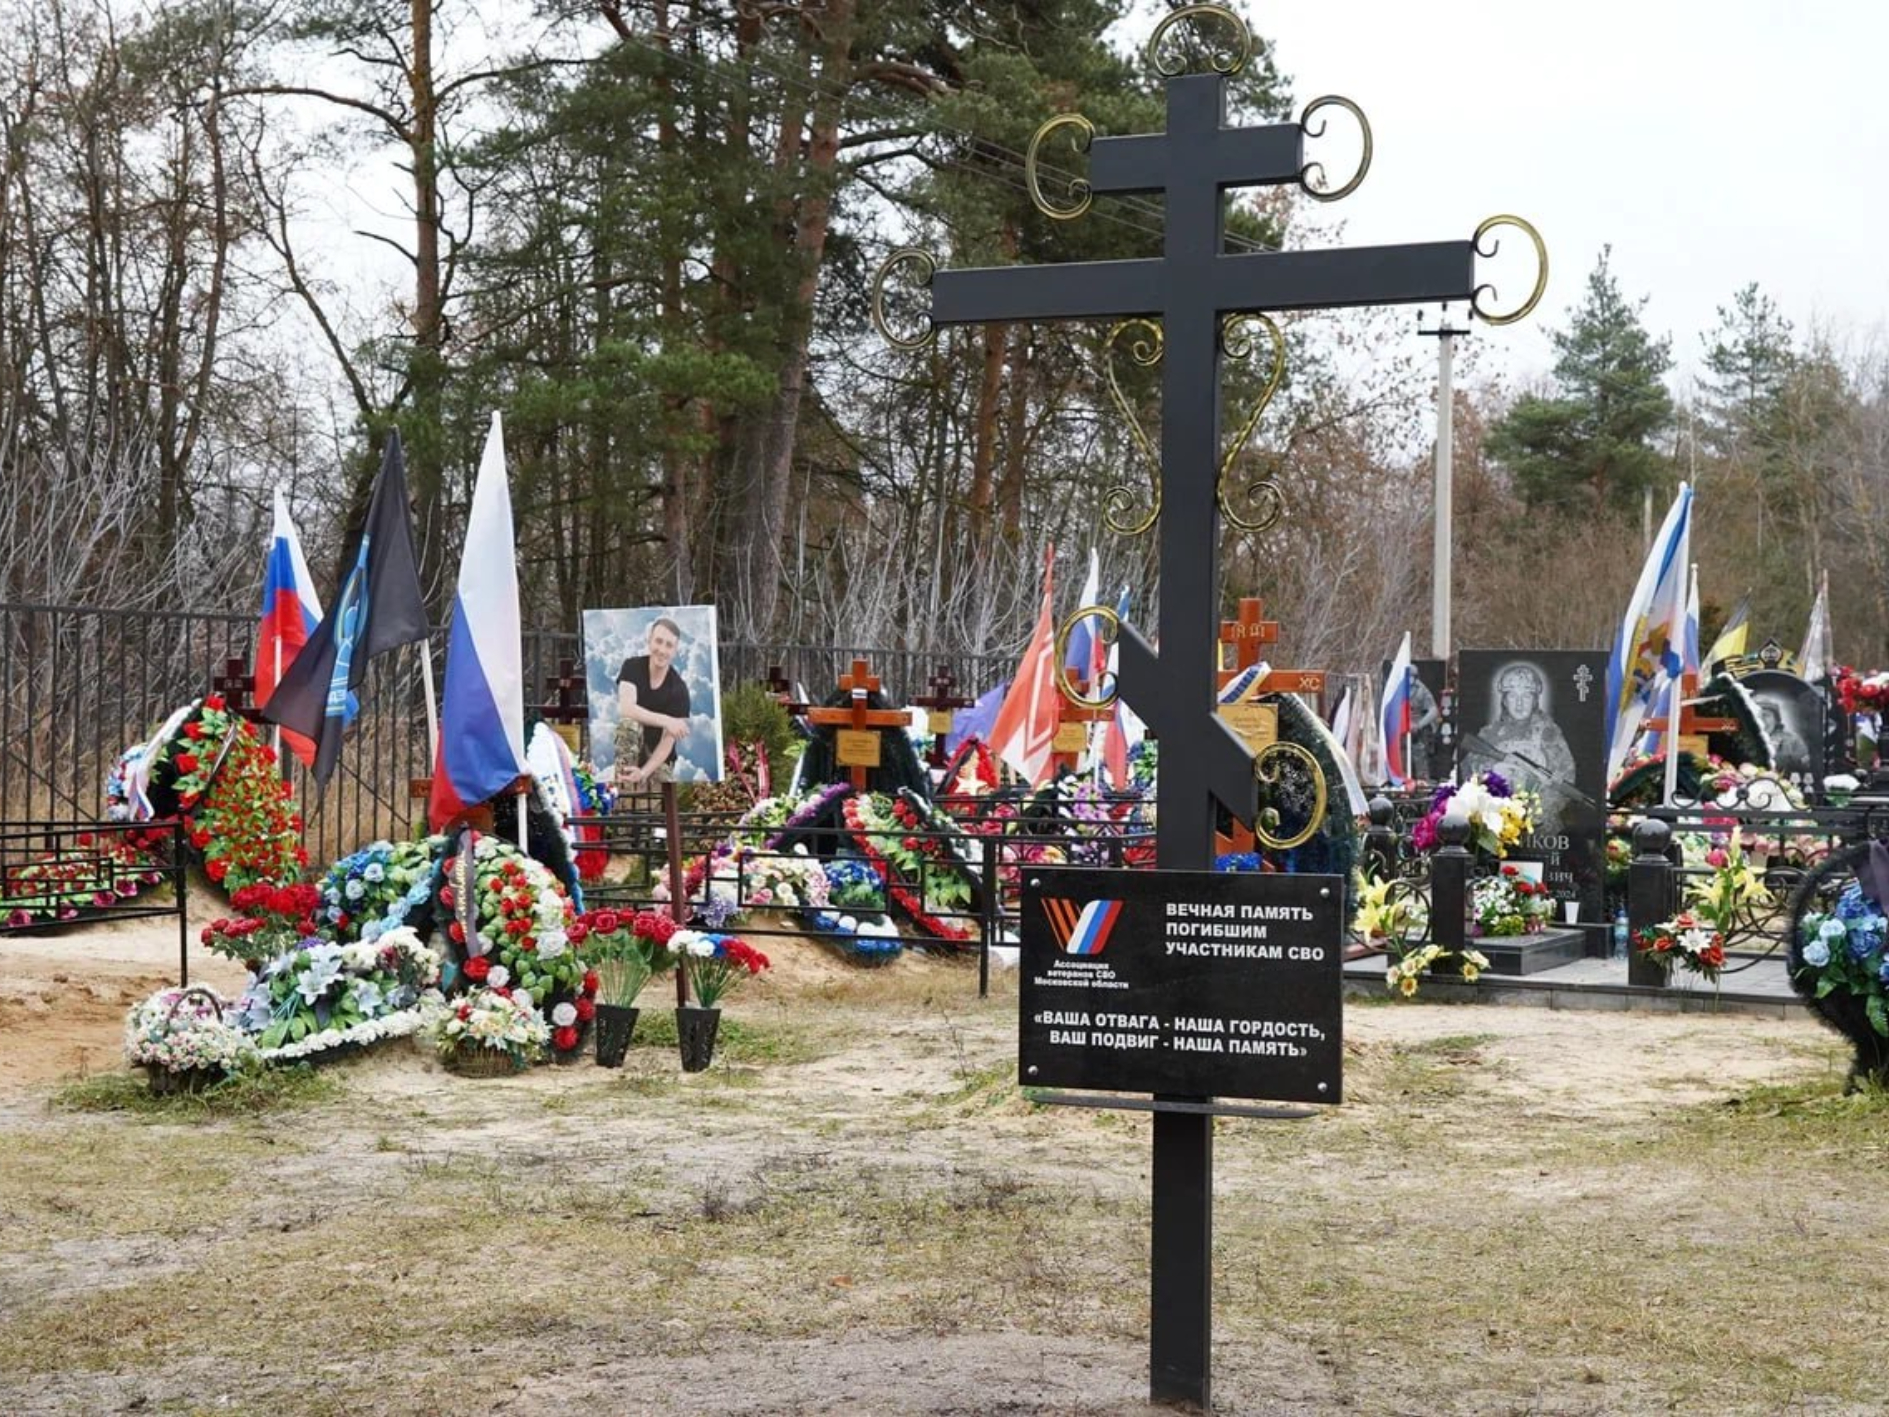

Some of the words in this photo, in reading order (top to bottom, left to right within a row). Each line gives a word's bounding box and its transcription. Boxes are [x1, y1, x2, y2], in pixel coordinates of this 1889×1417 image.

[1165, 903, 1236, 918] ВЕЧНАЯ
[1240, 905, 1314, 921] ПАМЯТЬ
[1165, 922, 1268, 939] ПОГИБШИМ
[1165, 942, 1283, 958] УЧАСТНИКАМ
[1287, 946, 1325, 961] СВО
[1053, 959, 1109, 970] Ассоциация
[1034, 976, 1089, 986] Московской
[1091, 979, 1129, 989] области
[1047, 969, 1093, 979] ветеранов
[1095, 970, 1116, 979] СВО
[1034, 1010, 1091, 1026] «ВАША
[1095, 1013, 1160, 1030] ОТВАГА
[1174, 1016, 1225, 1033] НАША
[1229, 1019, 1326, 1041] ГОРДОСТЬ,
[1049, 1030, 1086, 1045] ВАШ
[1091, 1031, 1159, 1050] ПОДВИГ
[1173, 1036, 1224, 1053] НАША
[1228, 1039, 1307, 1056] ПАМЯТЬ»
